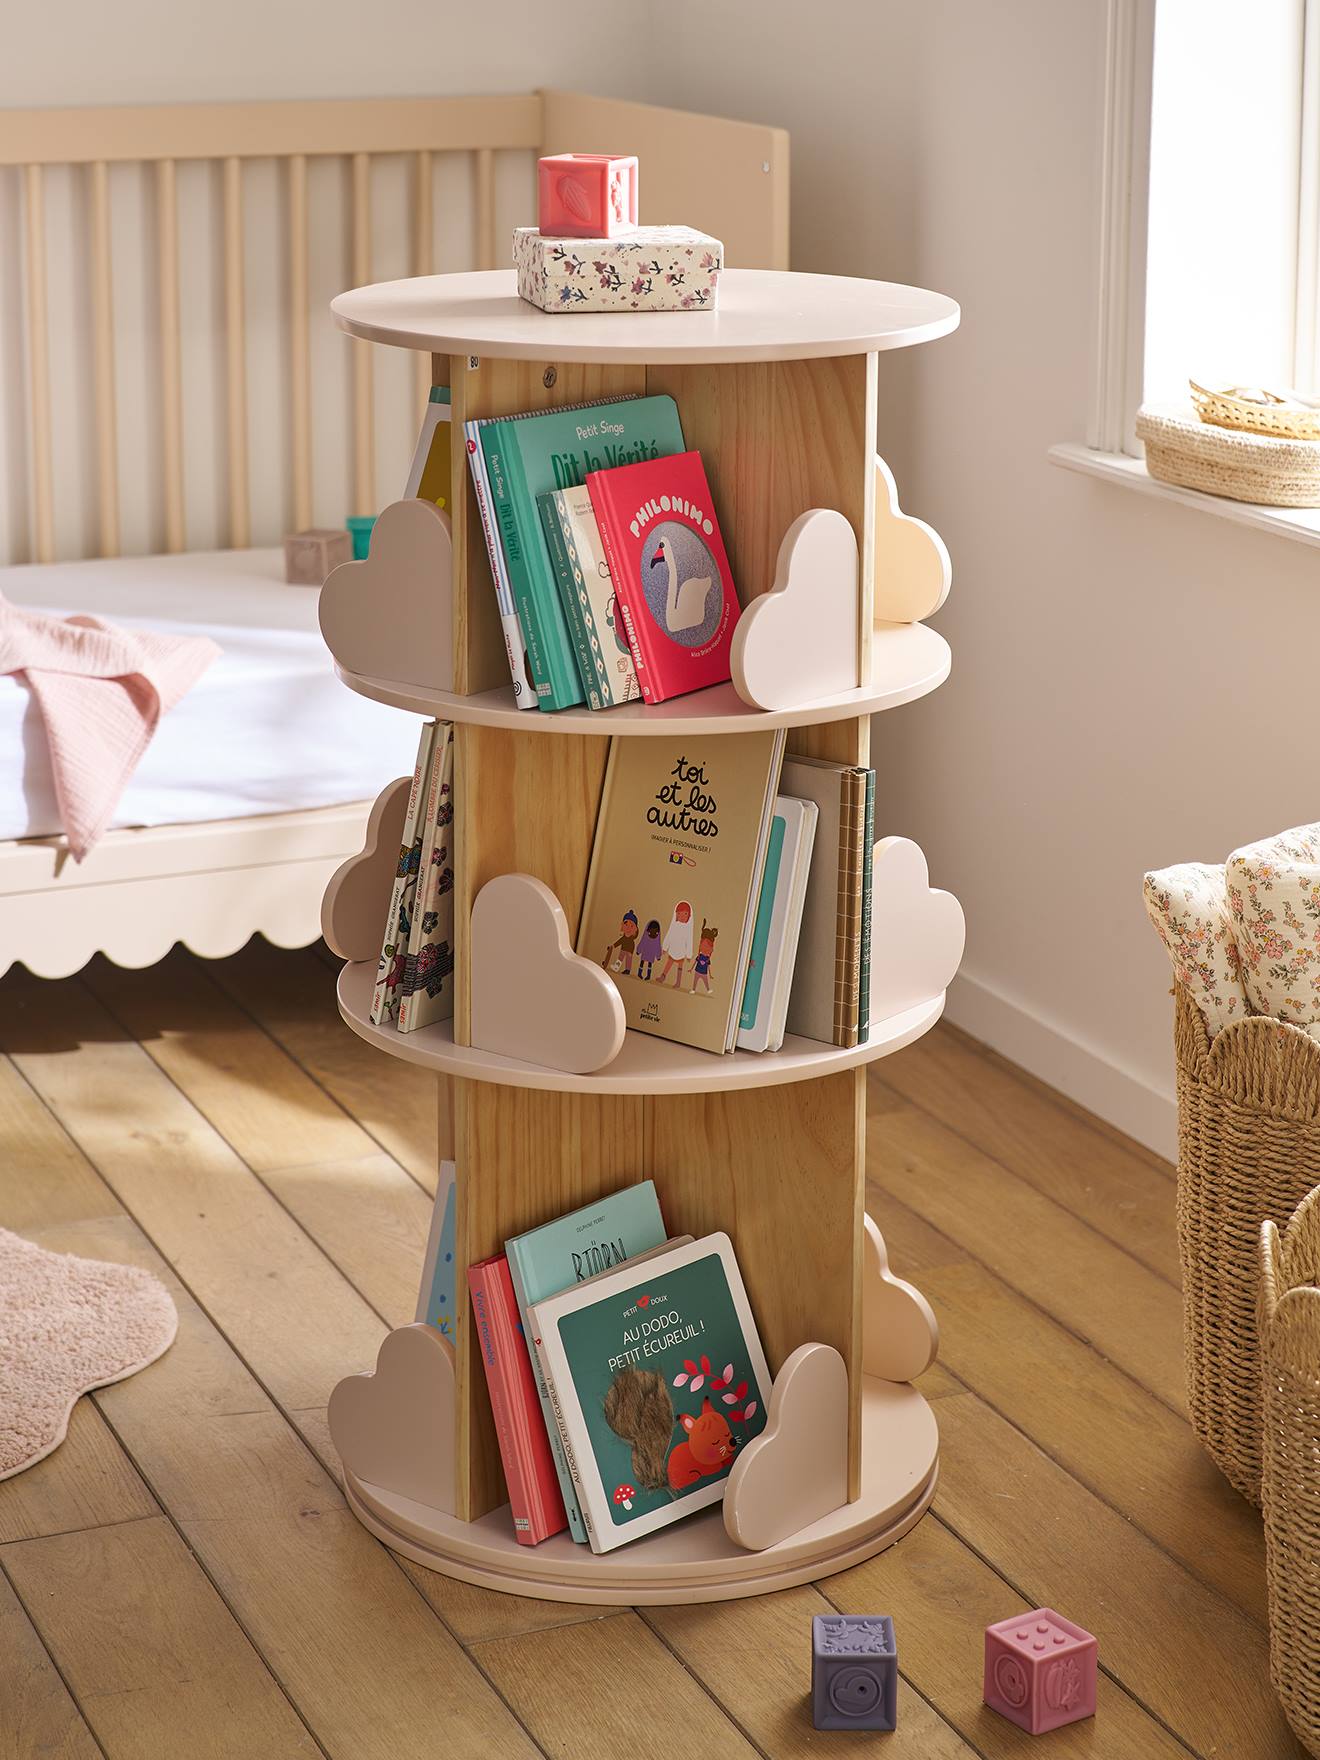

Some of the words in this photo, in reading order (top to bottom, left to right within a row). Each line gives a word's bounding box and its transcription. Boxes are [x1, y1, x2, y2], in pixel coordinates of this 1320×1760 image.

[576, 424, 598, 440] Petit
[600, 420, 625, 437] Singe
[490, 454, 500, 475] Petit
[495, 476, 505, 499] Singe
[551, 452, 580, 490] Dit
[500, 504, 512, 520] Dit
[629, 495, 714, 539] PHILONIMO
[504, 521, 514, 531] la
[621, 605, 645, 669] PHILONIMO
[671, 756, 709, 785] toi
[410, 786, 420, 809] CAPE
[655, 781, 683, 806] et
[684, 786, 716, 814] les
[407, 808, 415, 821] LA
[646, 807, 719, 837] autres
[413, 900, 422, 922] SOPHIE
[386, 919, 395, 941] SOPHIE
[863, 947, 872, 965] DES
[399, 1003, 407, 1025] samir
[622, 1305, 638, 1319] PETIT
[650, 1295, 669, 1306] DOUX
[475, 1291, 486, 1319] Vivre
[481, 1320, 495, 1366] ensemble
[623, 1327, 640, 1346] AU
[641, 1310, 683, 1337] DODO,
[607, 1347, 641, 1373] PETIT
[642, 1323, 700, 1358] ÉCUREUIL
[699, 1319, 706, 1333] !
[548, 1382, 562, 1421] ÉCUREUIL
[559, 1421, 569, 1443] PETIT
[572, 1471, 581, 1484] AU
